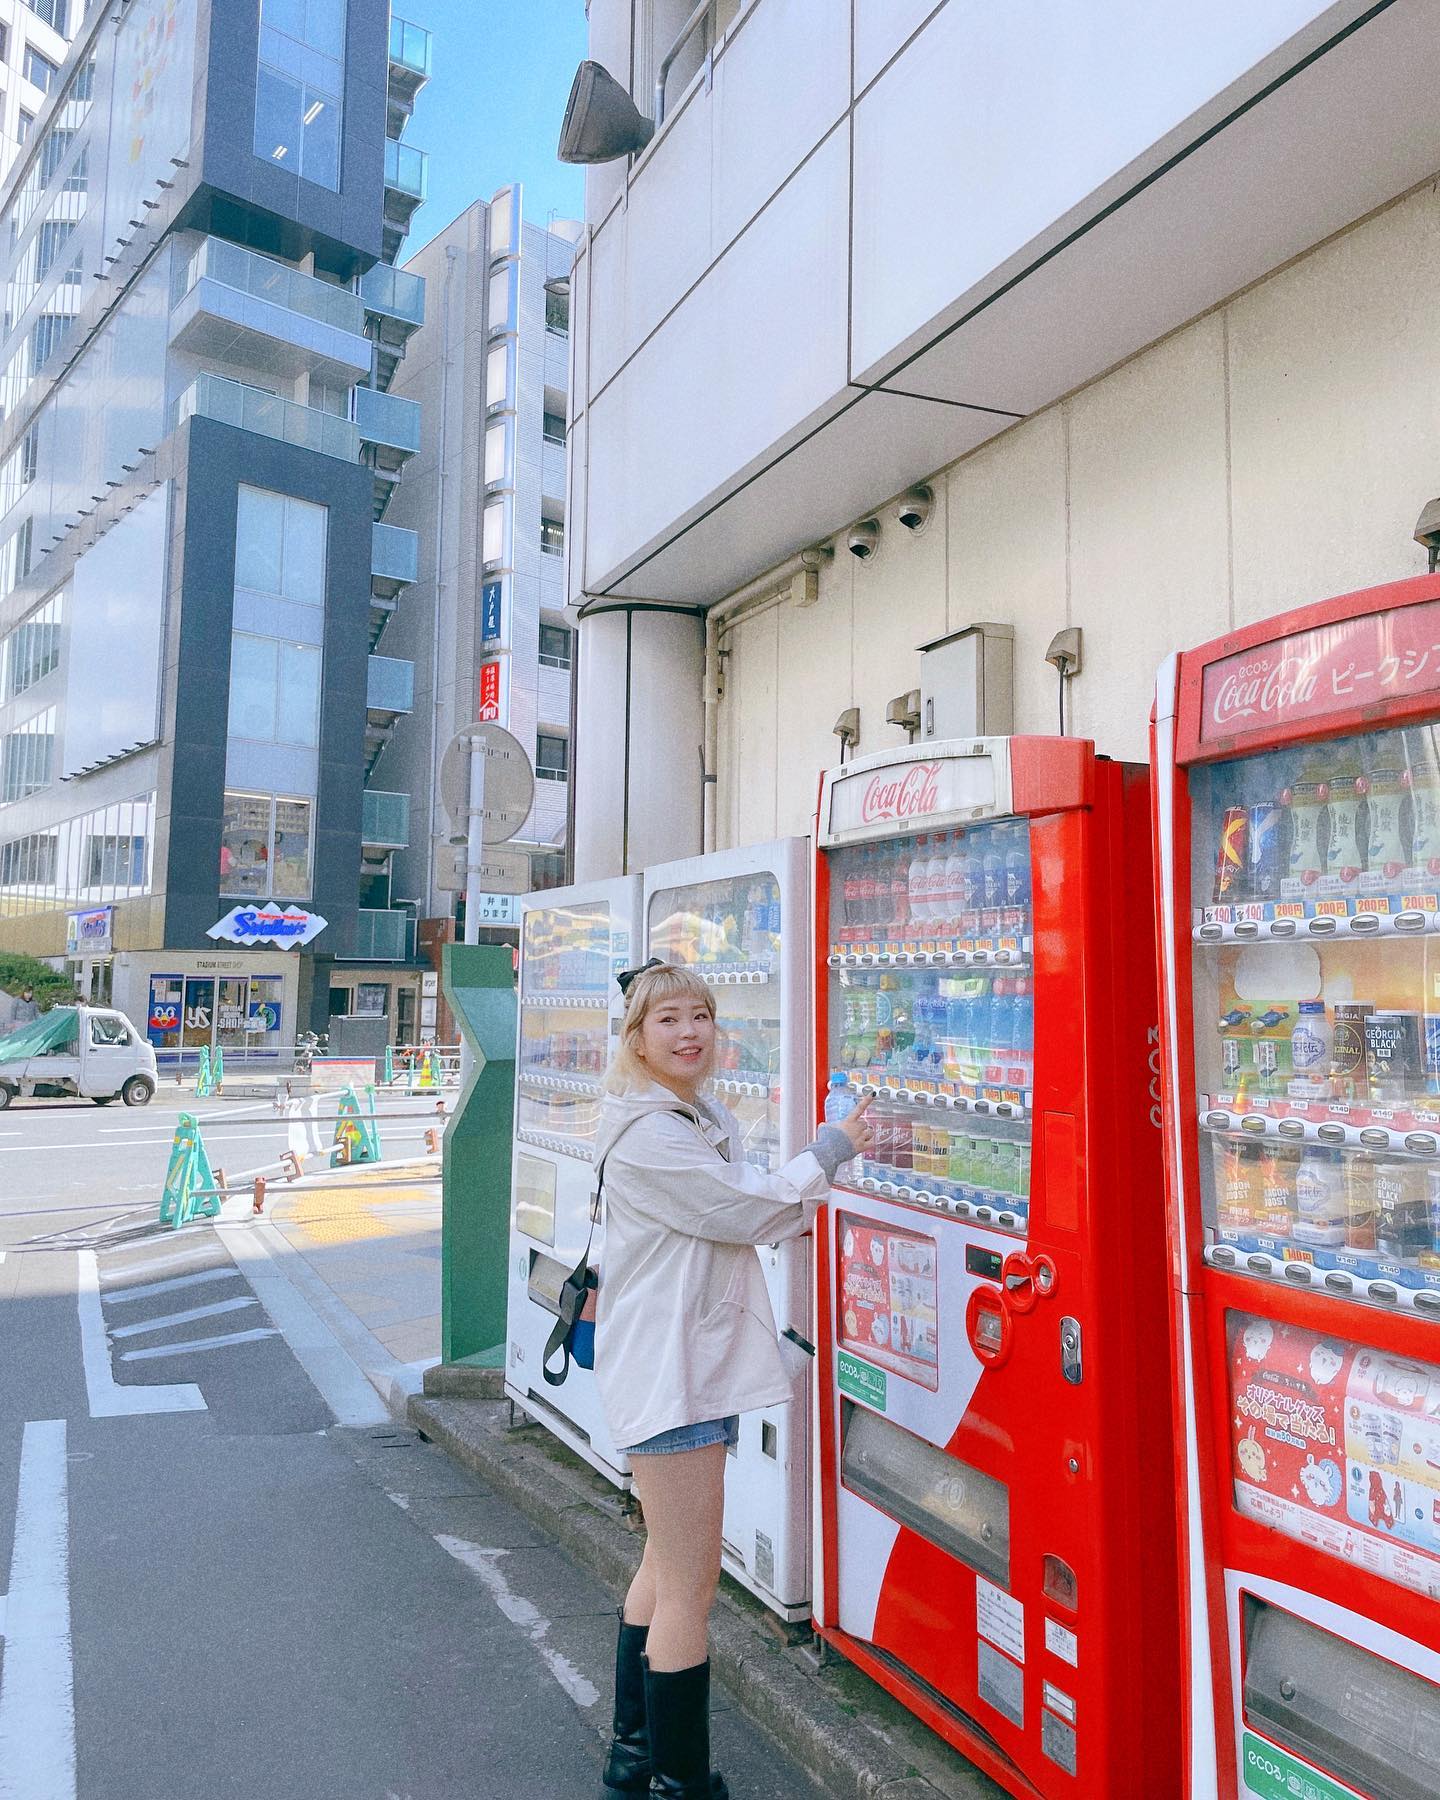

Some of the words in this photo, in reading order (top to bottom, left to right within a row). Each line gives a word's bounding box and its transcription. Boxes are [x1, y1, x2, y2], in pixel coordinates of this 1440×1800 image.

[488, 585, 496, 629] 大戸屋
[862, 760, 943, 823] Coca-Cola
[1317, 902, 1346, 915] 200円
[1358, 899, 1388, 913] 200円
[1404, 895, 1436, 909] 200円
[1371, 1039, 1396, 1049] BLACK
[1377, 1188, 1399, 1202] BLACK
[1246, 1383, 1325, 1424] オリジナルグッズ
